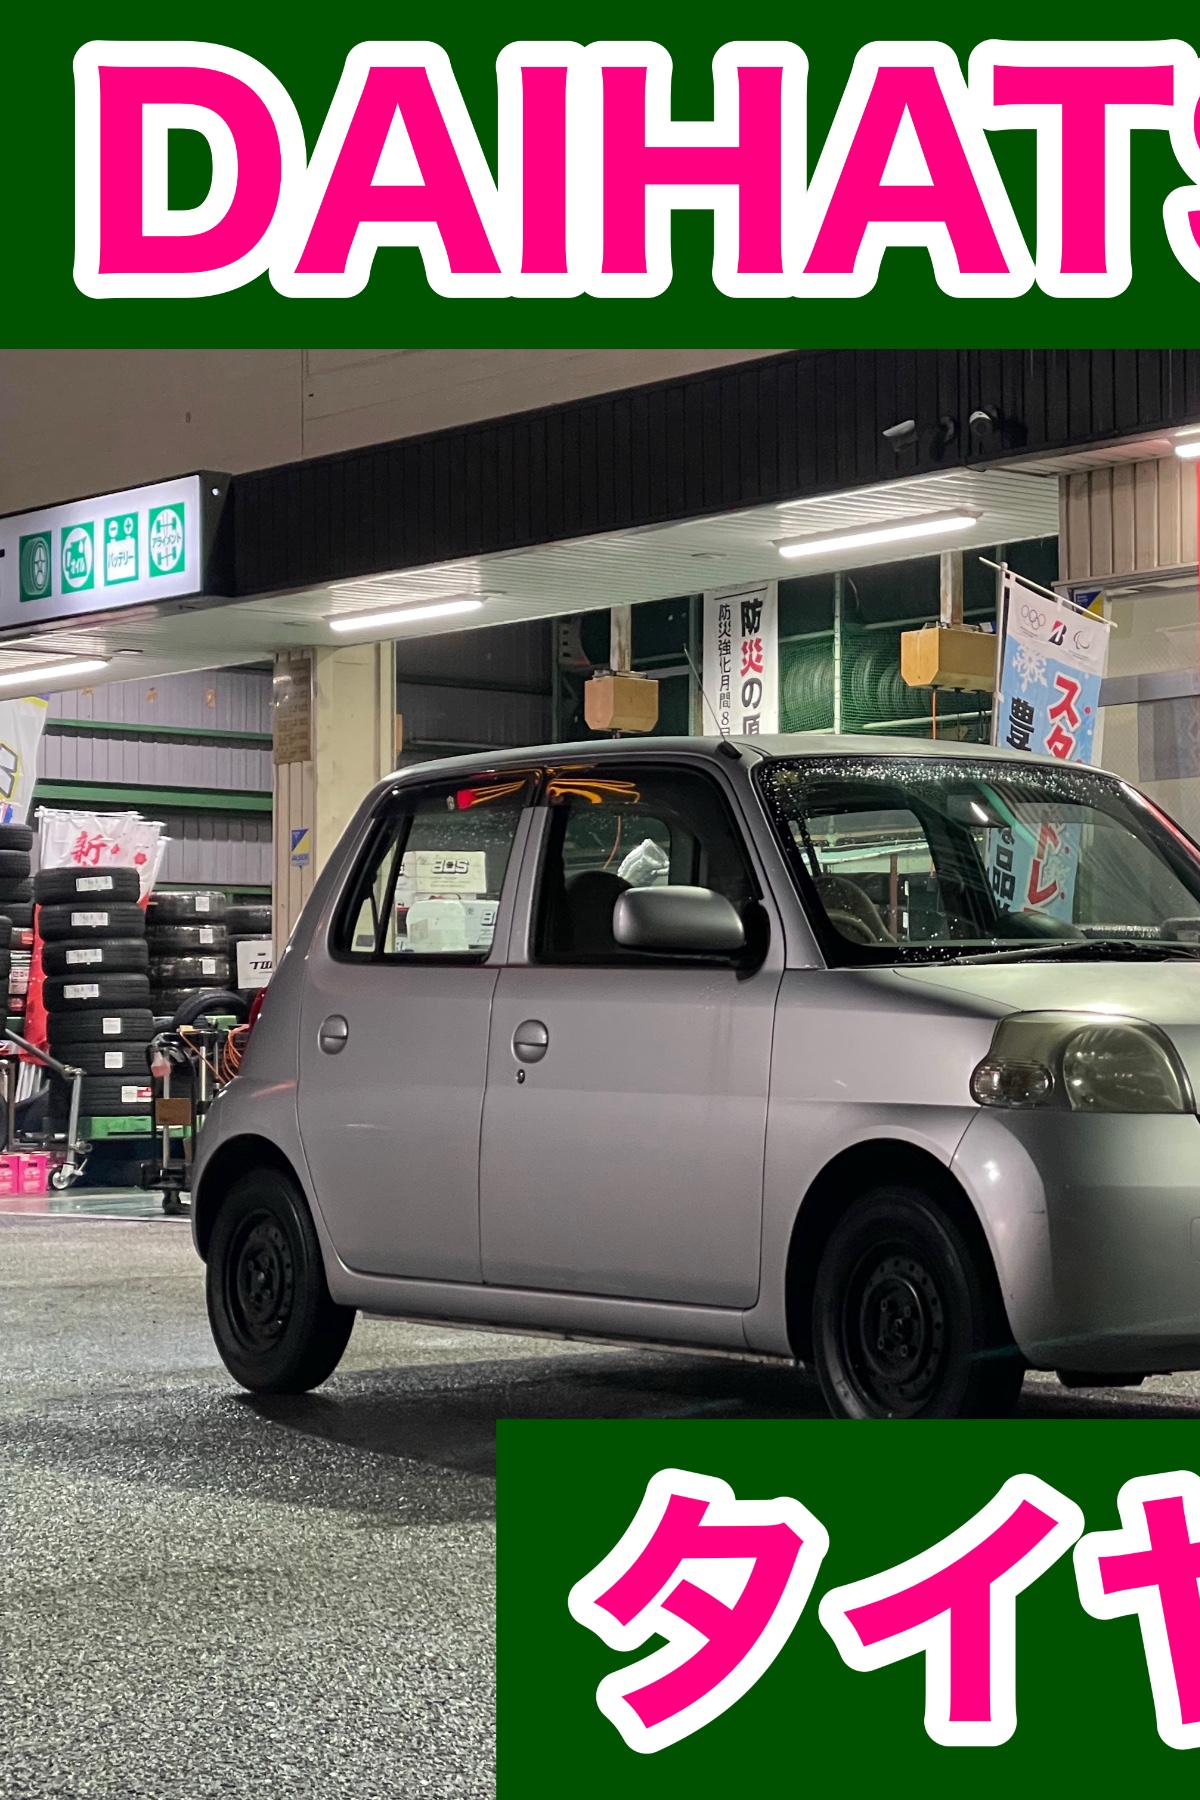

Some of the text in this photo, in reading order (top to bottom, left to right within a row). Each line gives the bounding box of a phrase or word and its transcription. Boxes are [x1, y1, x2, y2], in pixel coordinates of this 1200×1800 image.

[151, 534, 182, 549] アライメント
[70, 556, 87, 575] オイル
[107, 551, 135, 568] バッテリー
